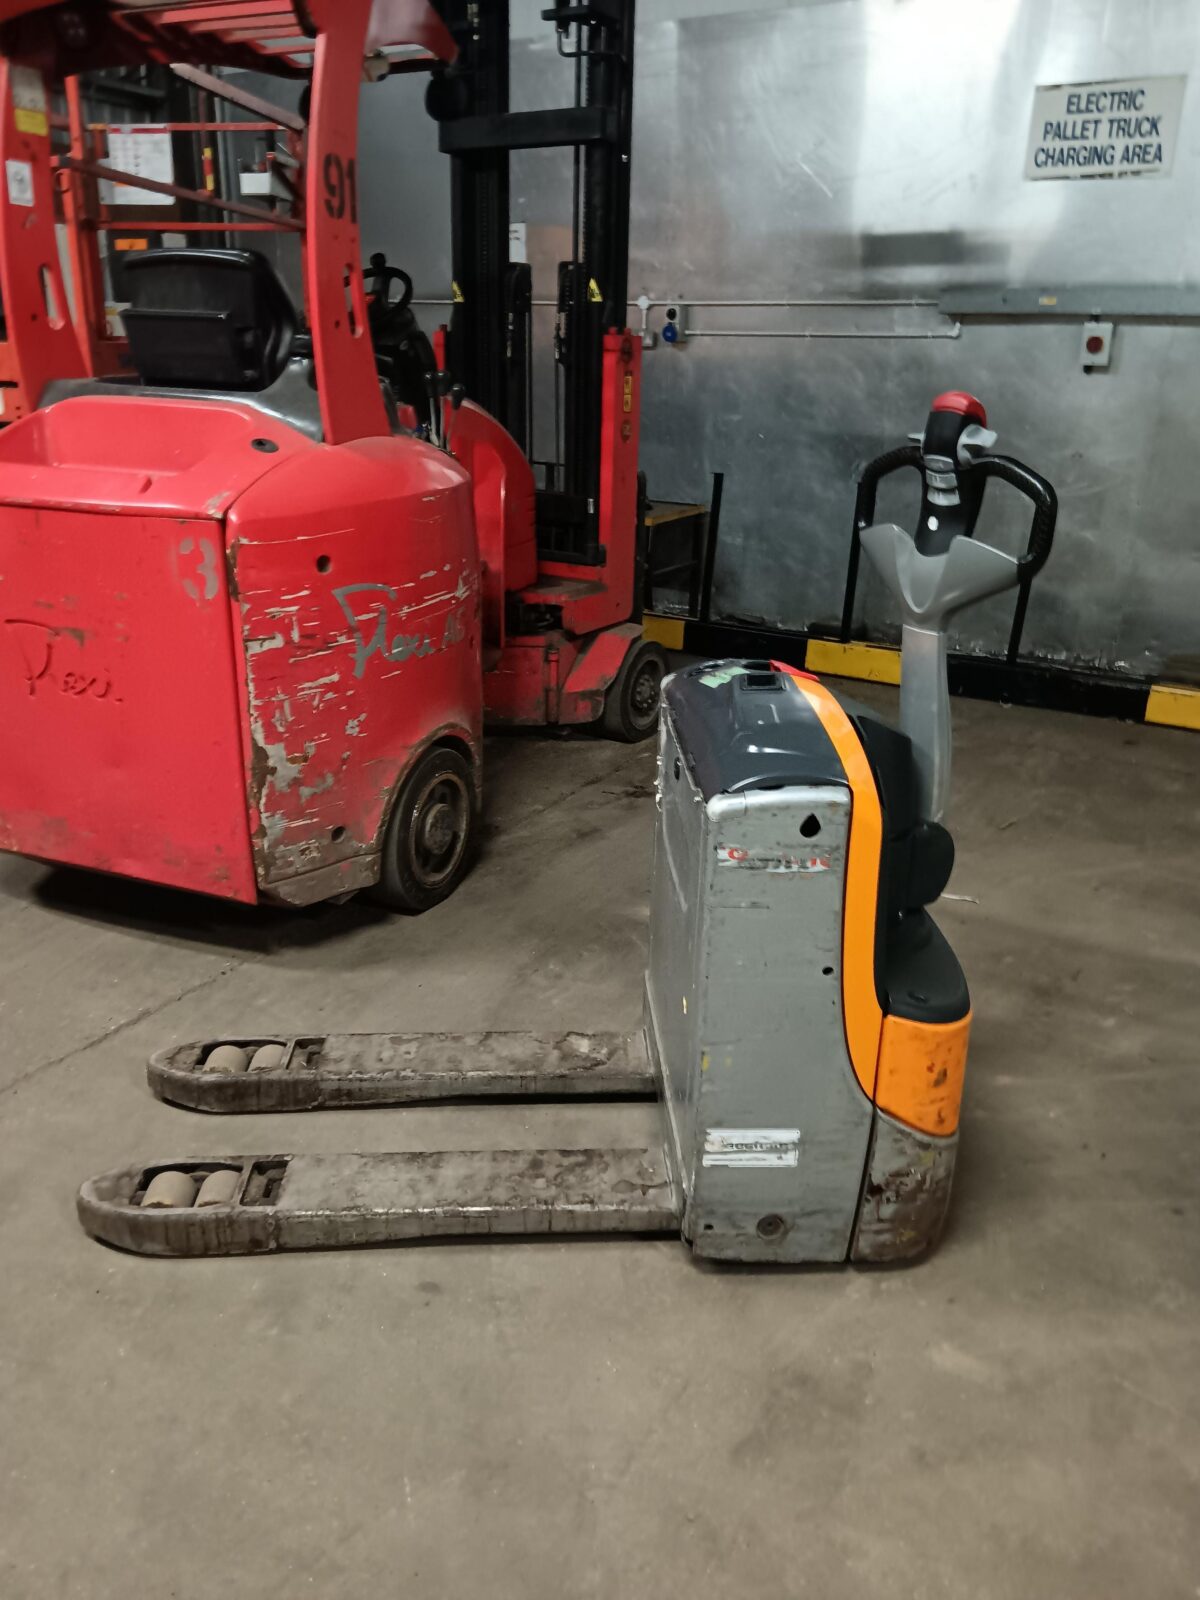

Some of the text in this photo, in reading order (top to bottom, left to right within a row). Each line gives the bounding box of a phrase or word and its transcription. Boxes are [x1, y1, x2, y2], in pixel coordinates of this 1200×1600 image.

[1065, 89, 1146, 115] ELECTRIC
[1042, 115, 1163, 142] PALLET TRUCK
[1033, 143, 1163, 168] CHARGING AREA
[323, 152, 357, 225] 91
[178, 536, 219, 601] 3
